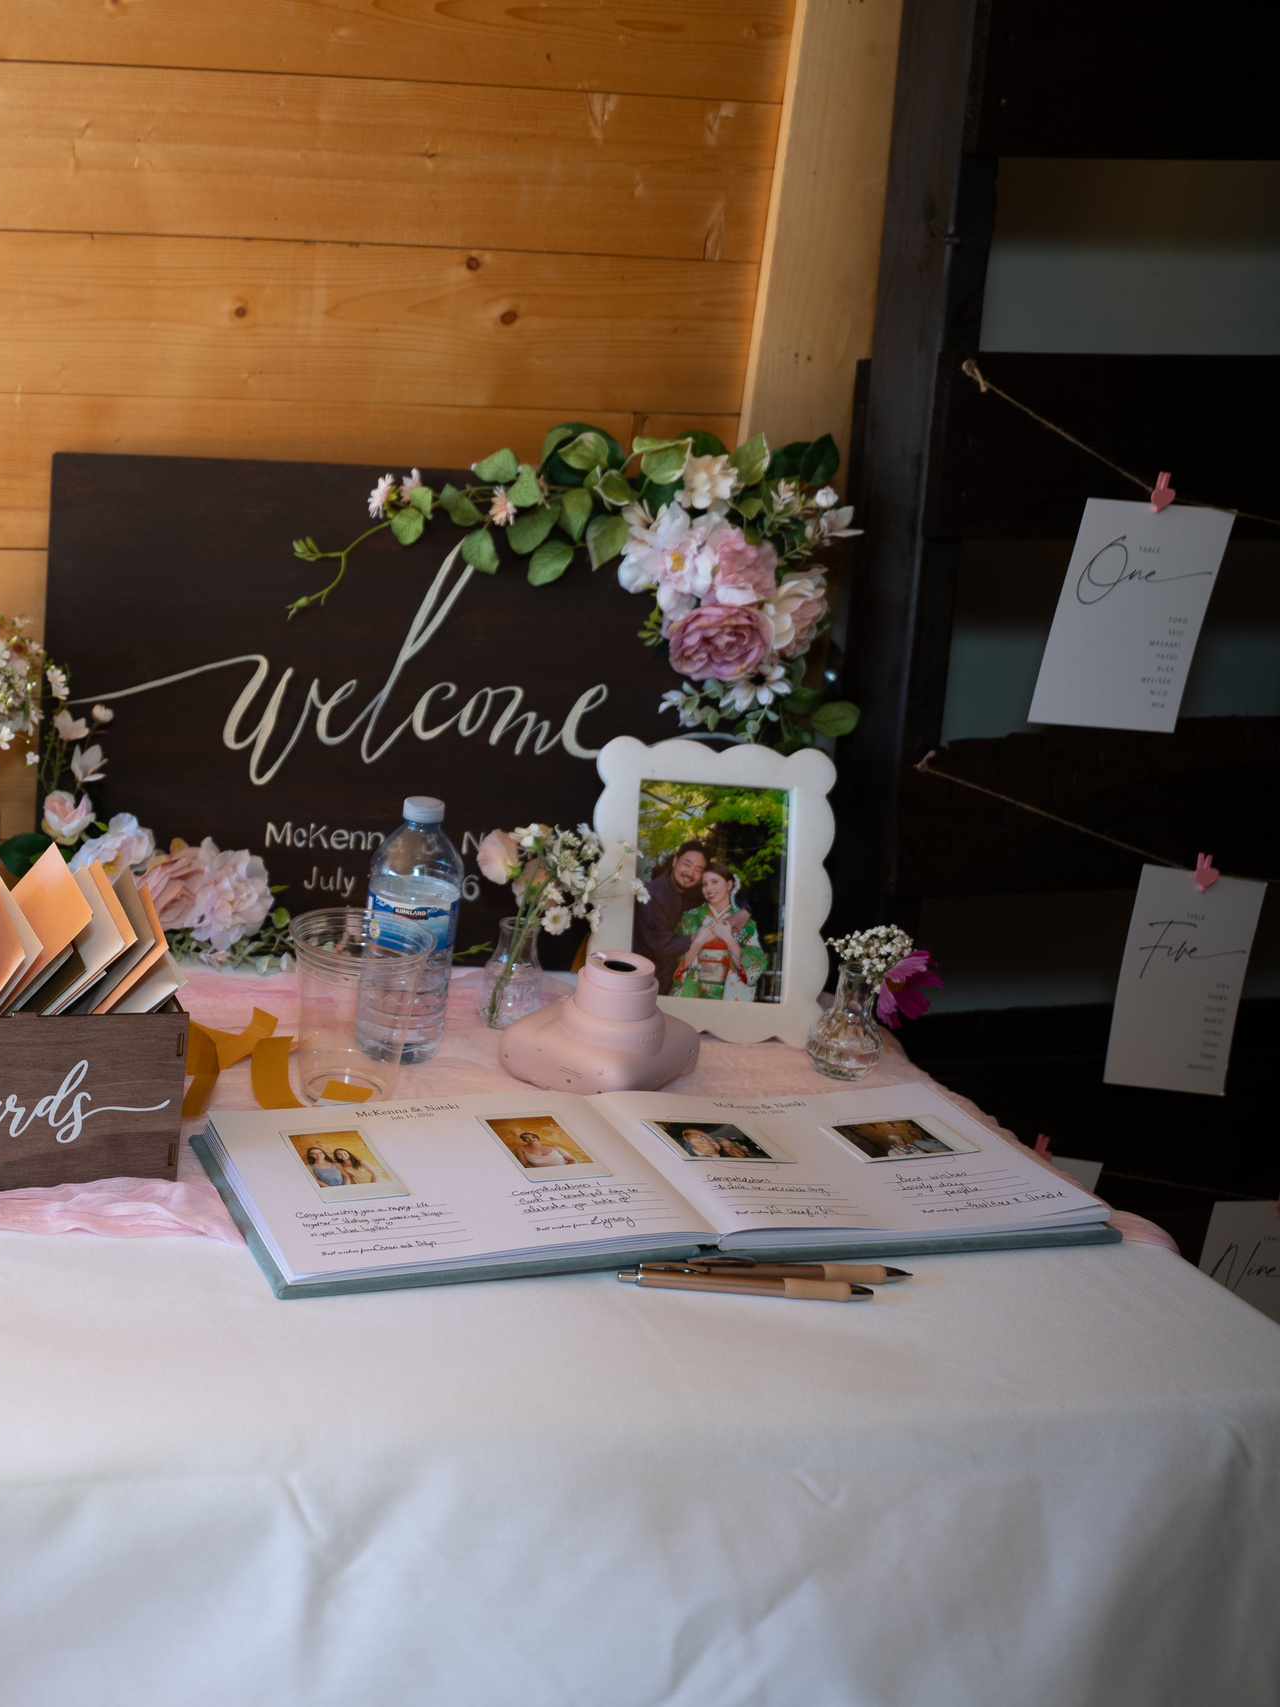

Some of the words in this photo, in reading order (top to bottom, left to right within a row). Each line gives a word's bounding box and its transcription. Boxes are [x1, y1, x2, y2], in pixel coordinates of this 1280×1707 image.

[1138, 545, 1161, 554] TABLE
[1076, 534, 1213, 605] One
[67, 534, 607, 786] welcome
[1140, 676, 1171, 685] MELISSA
[1151, 701, 1165, 709] MIA
[303, 866, 356, 898] July
[395, 907, 427, 916] KIRKLAND
[1139, 919, 1247, 979] Five
[355, 1107, 408, 1118] McKenna
[410, 1105, 422, 1113] &
[712, 1101, 761, 1110] McKenna
[929, 1170, 967, 1180] wishes
[360, 1208, 375, 1216] you
[388, 1204, 411, 1212] happy
[1209, 1241, 1280, 1293] Nine
